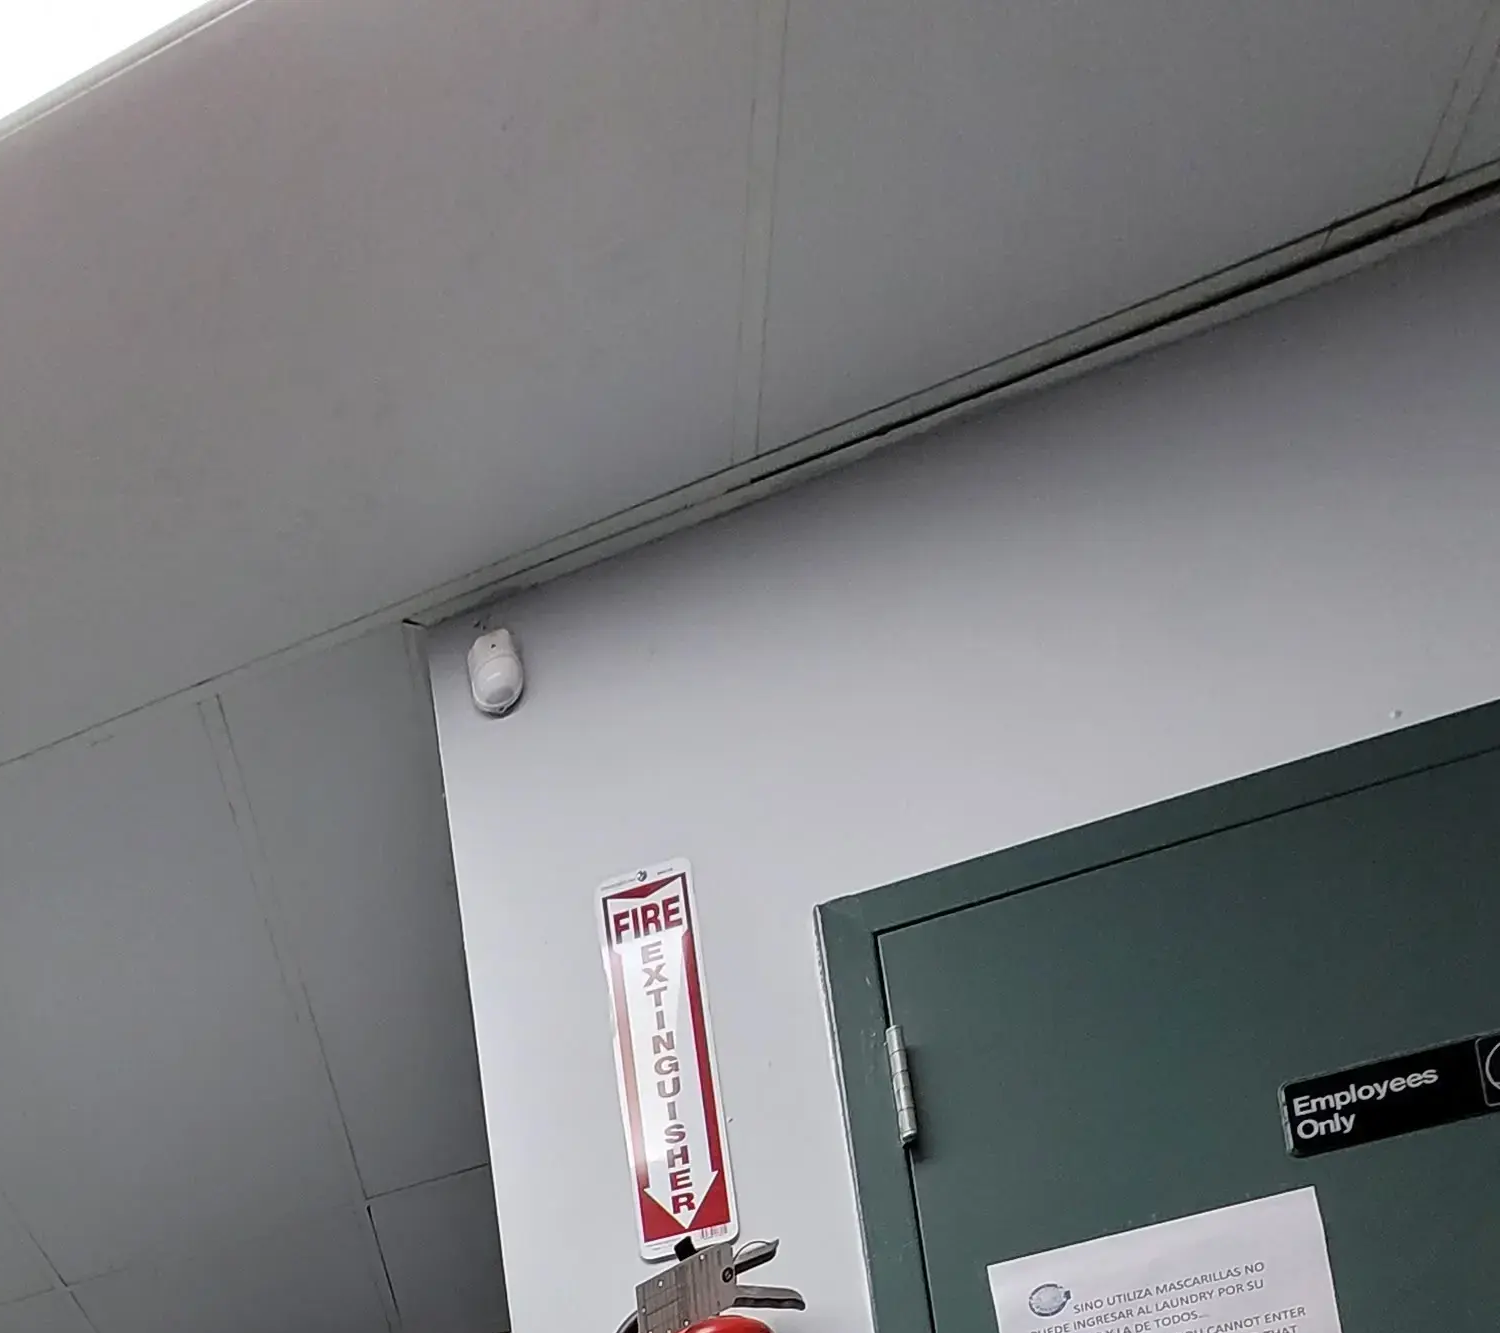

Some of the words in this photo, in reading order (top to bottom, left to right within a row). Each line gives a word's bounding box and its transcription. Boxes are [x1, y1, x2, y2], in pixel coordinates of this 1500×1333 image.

[613, 895, 683, 945] FIRE
[640, 940, 696, 1214] EXTINGUISHER
[1293, 1069, 1439, 1116] Employees
[1297, 1113, 1356, 1139] Only
[1073, 1299, 1104, 1314] SINO
[1107, 1288, 1153, 1306] UTILIZA
[1155, 1266, 1242, 1295] MASCARILLAS
[1244, 1261, 1265, 1275] NO
[1073, 1308, 1134, 1331] INGRESAR
[1137, 1305, 1153, 1317] AL
[1155, 1289, 1214, 1313] LAUNDRY
[1218, 1283, 1245, 1297] POR
[1247, 1279, 1264, 1292] SU
[1134, 1321, 1152, 1333] DE
[1264, 1306, 1307, 1324] ENTER
